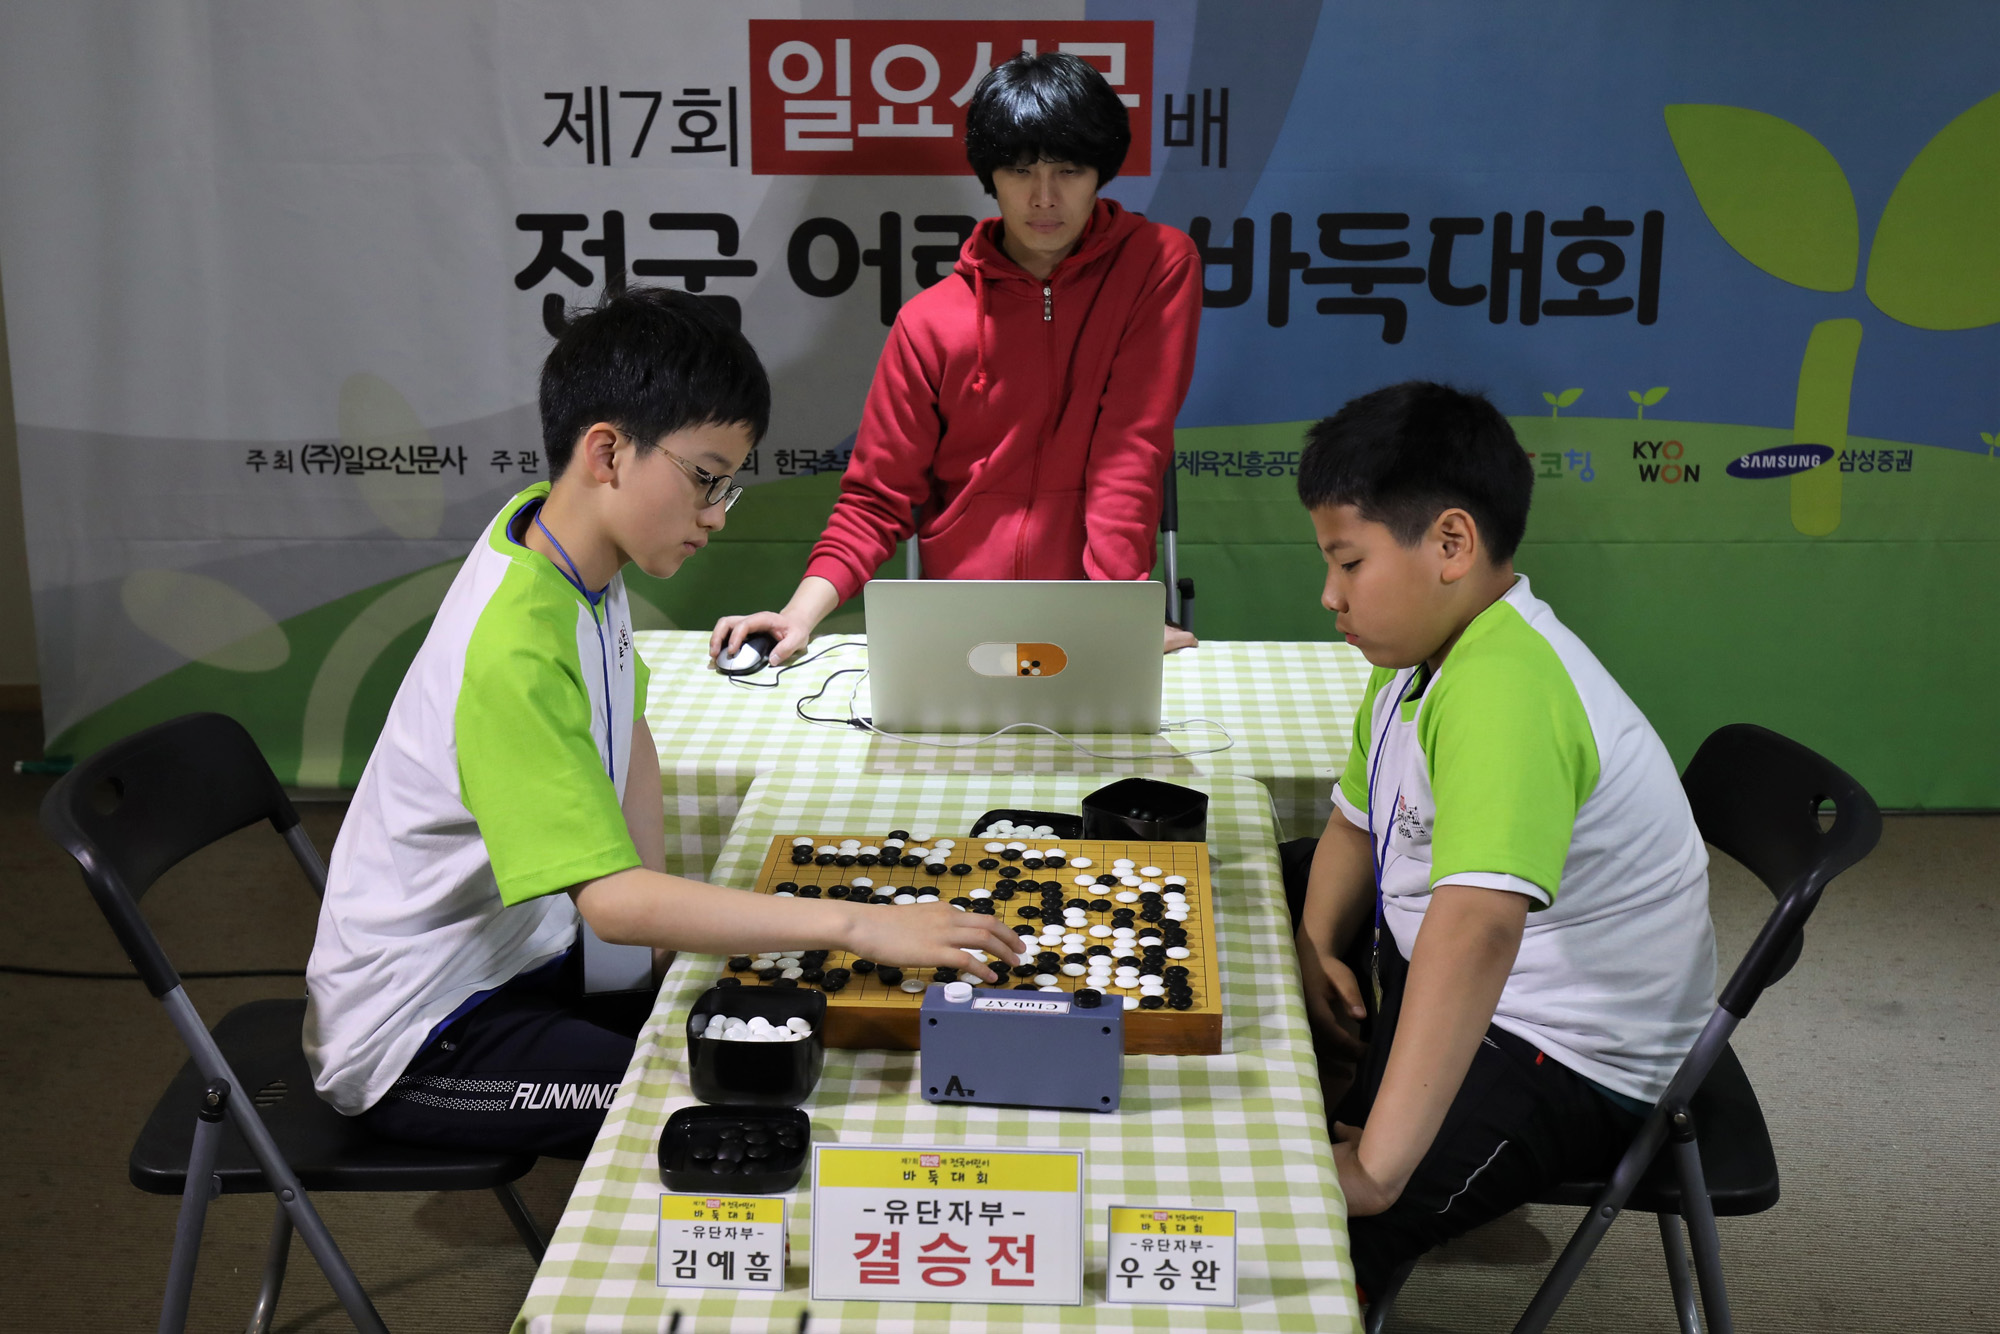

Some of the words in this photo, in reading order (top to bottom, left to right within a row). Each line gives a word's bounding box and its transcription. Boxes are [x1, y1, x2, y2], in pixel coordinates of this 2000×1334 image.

[542, 85, 739, 168] 제7회
[767, 39, 1140, 153] 일요
[1163, 87, 1229, 169] 배
[1188, 205, 1665, 345] 바둑대회
[245, 449, 293, 473] 주최
[301, 445, 467, 476] (주)일요신문사
[490, 450, 540, 474] 주관
[1174, 450, 1300, 477] 체육진흥공
[1527, 448, 1595, 483] 코칭
[1633, 440, 1684, 460] KYO
[1740, 454, 1821, 469] SAMSUNG
[1837, 449, 1914, 473] 삼성증권
[1638, 464, 1700, 484] WON
[1014, 1001, 1058, 1011] Club
[672, 1249, 772, 1282] 김예흠
[853, 1231, 1035, 1287] 결승전
[1116, 1257, 1220, 1291] 우승완
